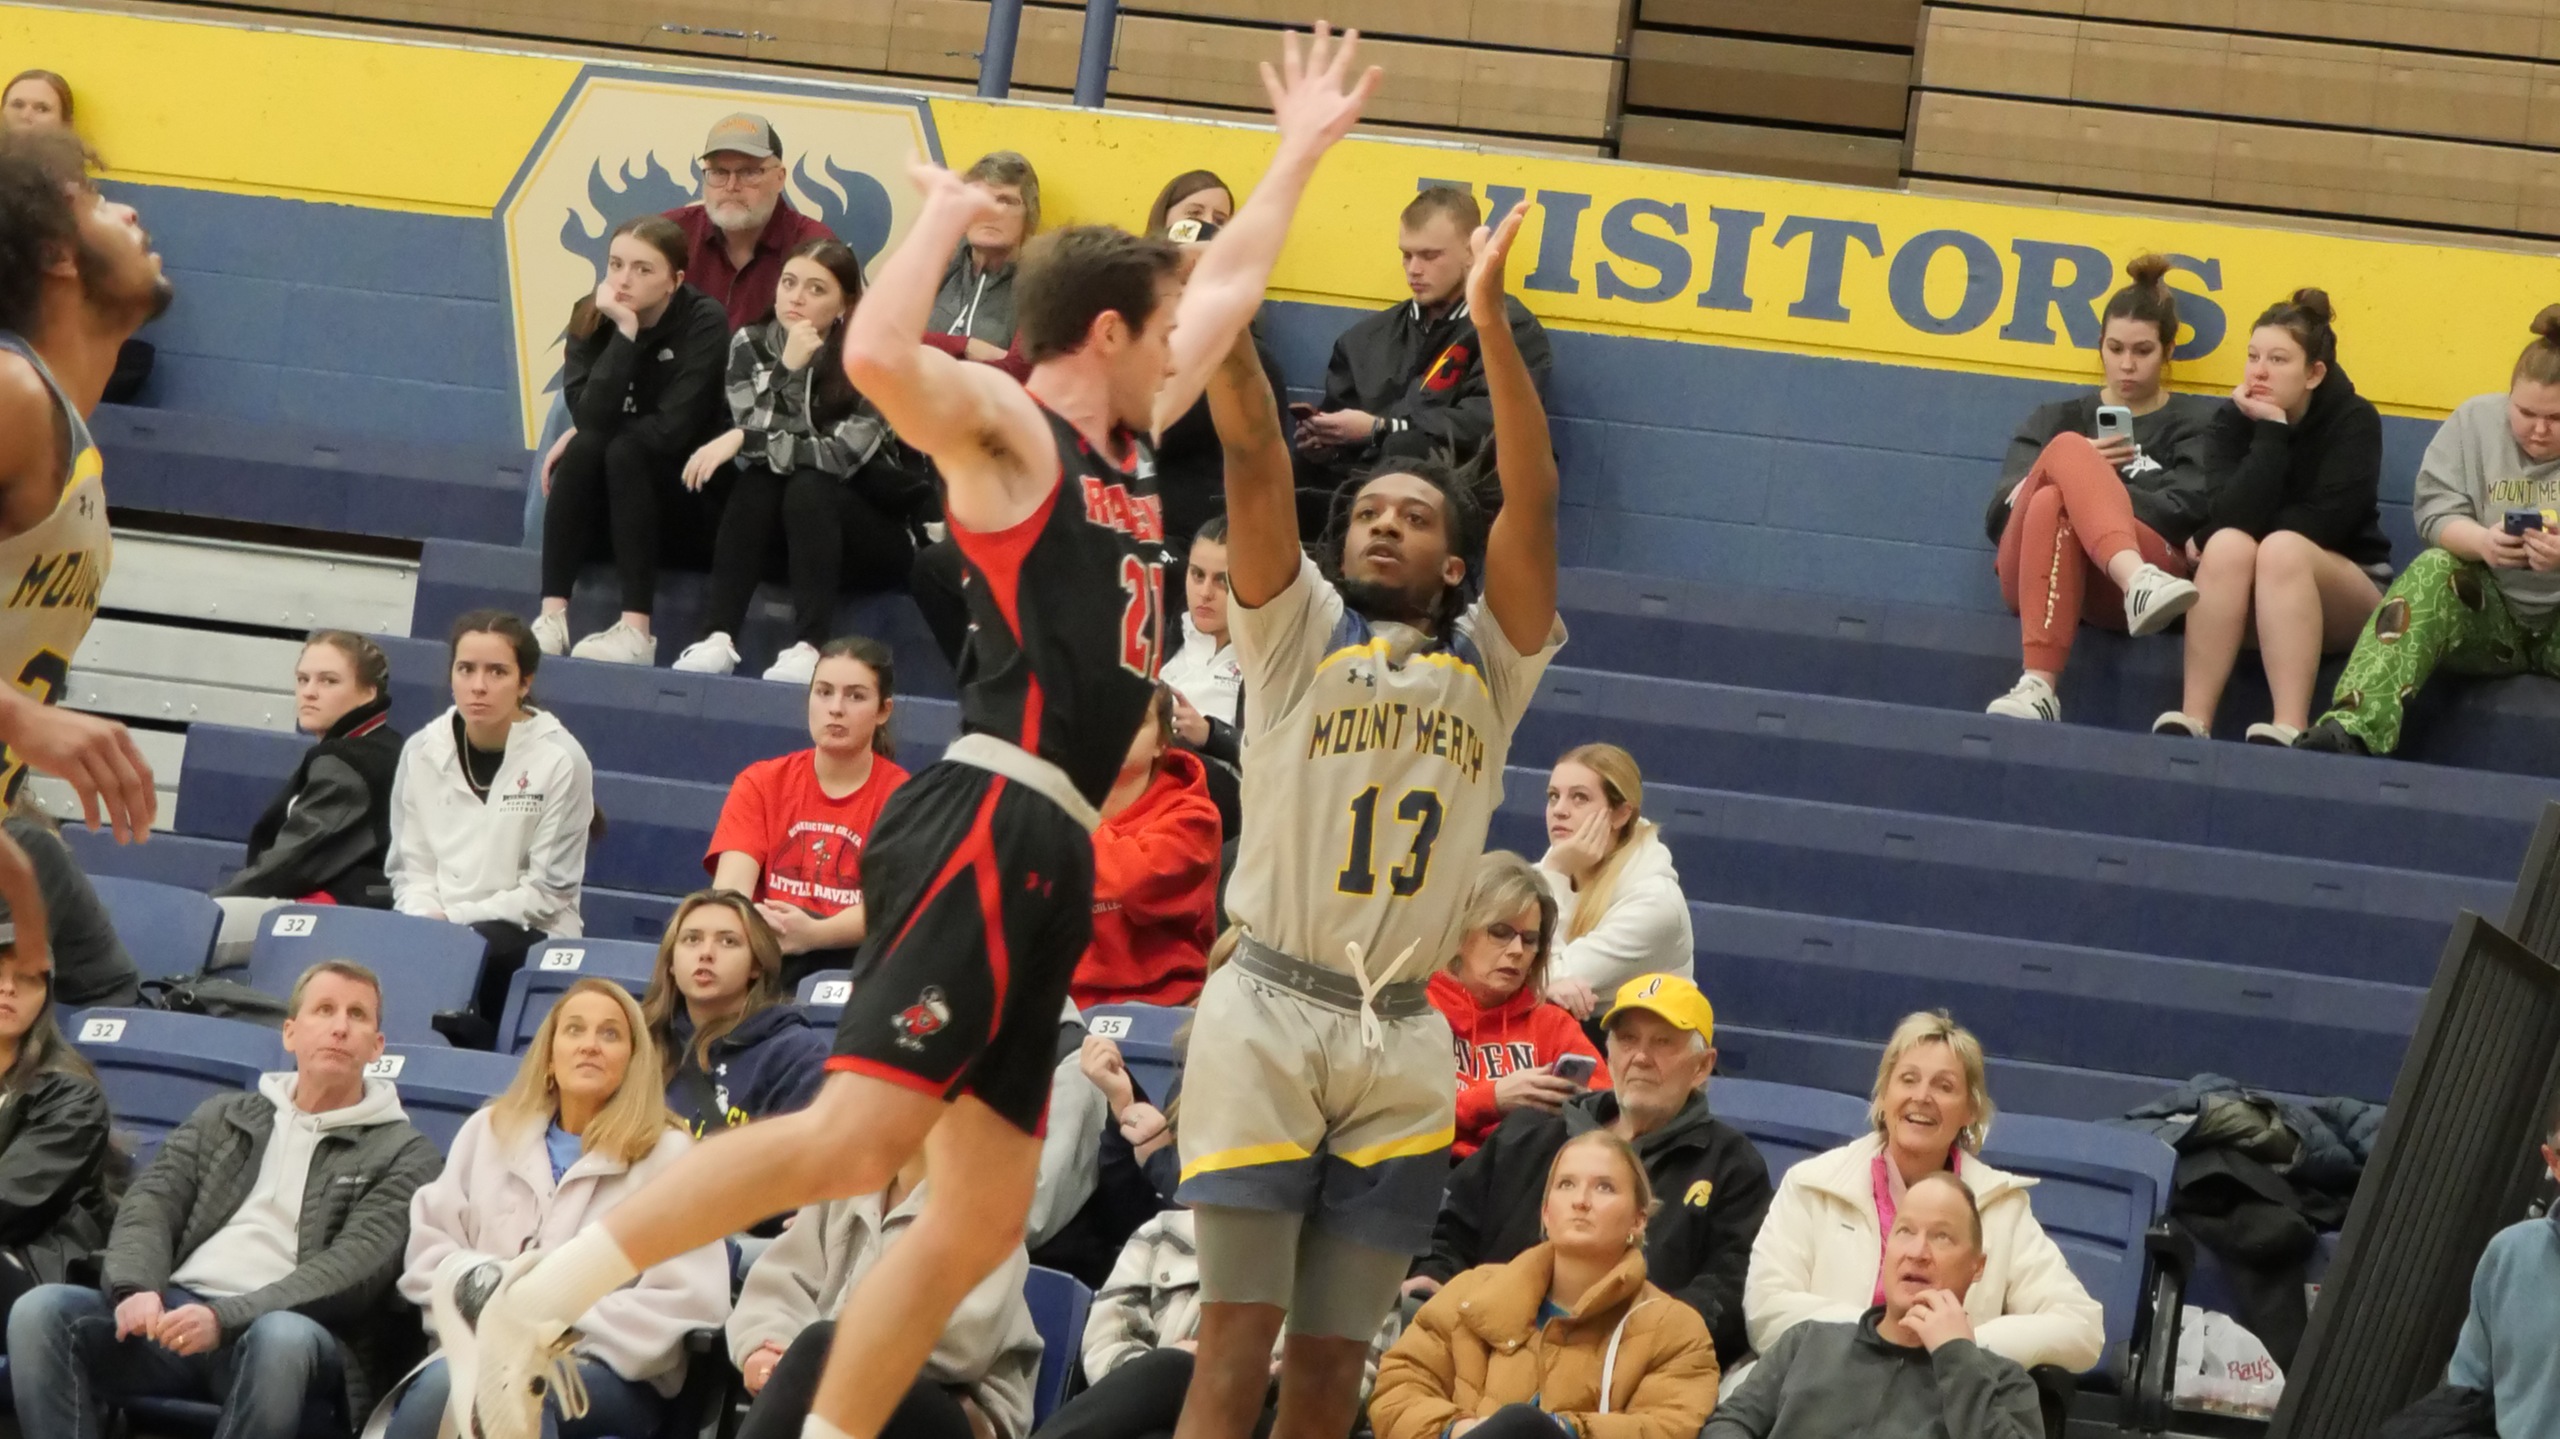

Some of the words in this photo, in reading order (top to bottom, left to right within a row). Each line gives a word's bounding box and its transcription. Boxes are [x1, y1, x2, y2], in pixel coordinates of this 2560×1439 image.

[2487, 479, 2534, 504] MOUNT
[2538, 480, 2560, 504] ME
[1307, 702, 1408, 760] MOUNT
[1336, 784, 1445, 897] 13
[814, 883, 863, 905] RAVEN
[284, 918, 306, 932] 32
[552, 952, 574, 966] 33
[822, 985, 845, 999] 34
[92, 1022, 114, 1037] 32
[1099, 1020, 1122, 1034] 35
[370, 1059, 394, 1073] 33
[2227, 1355, 2275, 1383] Ray's
